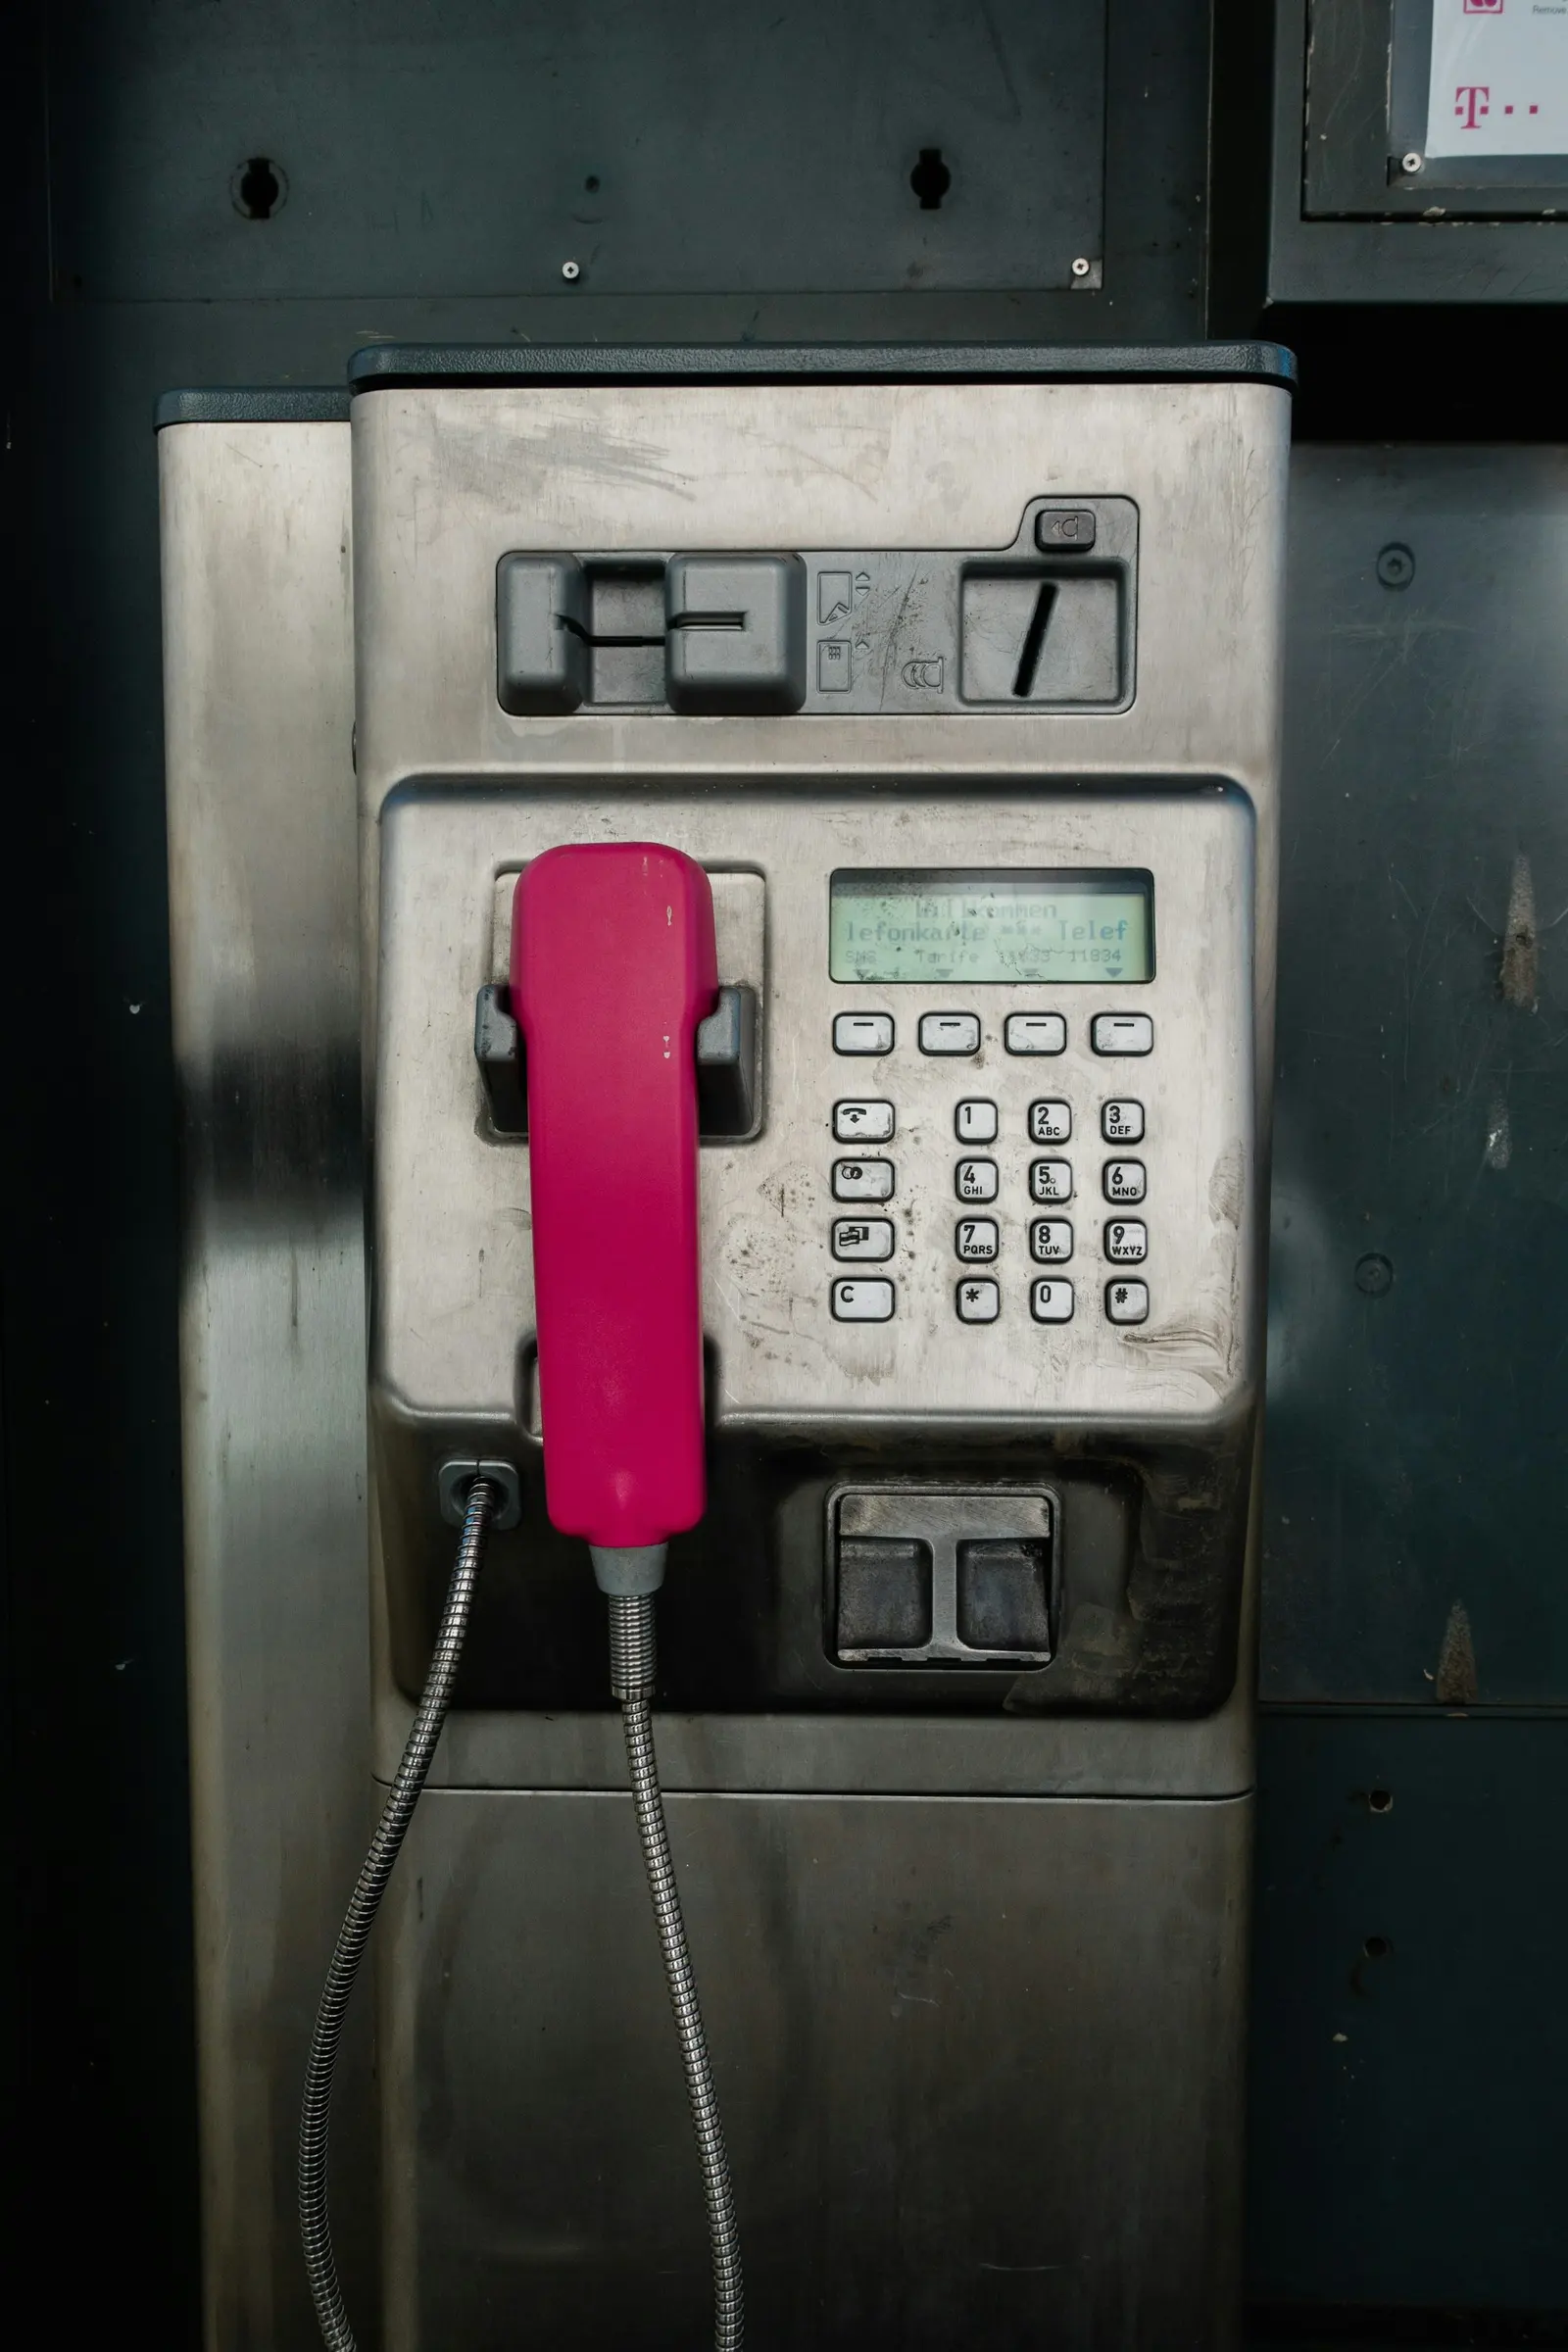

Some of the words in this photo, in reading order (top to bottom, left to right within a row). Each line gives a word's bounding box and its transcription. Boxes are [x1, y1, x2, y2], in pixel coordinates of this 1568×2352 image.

[1058, 919, 1129, 940] Telef
[1070, 949, 1121, 962] 11834
[964, 1106, 971, 1124] 1
[1038, 1106, 1050, 1124] 2
[1109, 1105, 1121, 1124] 3
[1038, 1126, 1060, 1136] ABC
[1109, 1126, 1131, 1135] DEF
[963, 1165, 976, 1184] 4
[1039, 1165, 1051, 1184] 5
[1111, 1166, 1123, 1185] 6
[963, 1186, 983, 1195] GHI
[1039, 1186, 1059, 1196] JKL
[1112, 1187, 1137, 1196] MNO
[963, 1225, 976, 1243] 7
[1038, 1225, 1052, 1244] 8
[1113, 1225, 1125, 1245] 9
[963, 1245, 993, 1255] PQRS
[1039, 1246, 1059, 1255] TUV
[1111, 1246, 1143, 1255] WXYZ
[840, 1285, 855, 1303] C
[1040, 1285, 1052, 1303] 0
